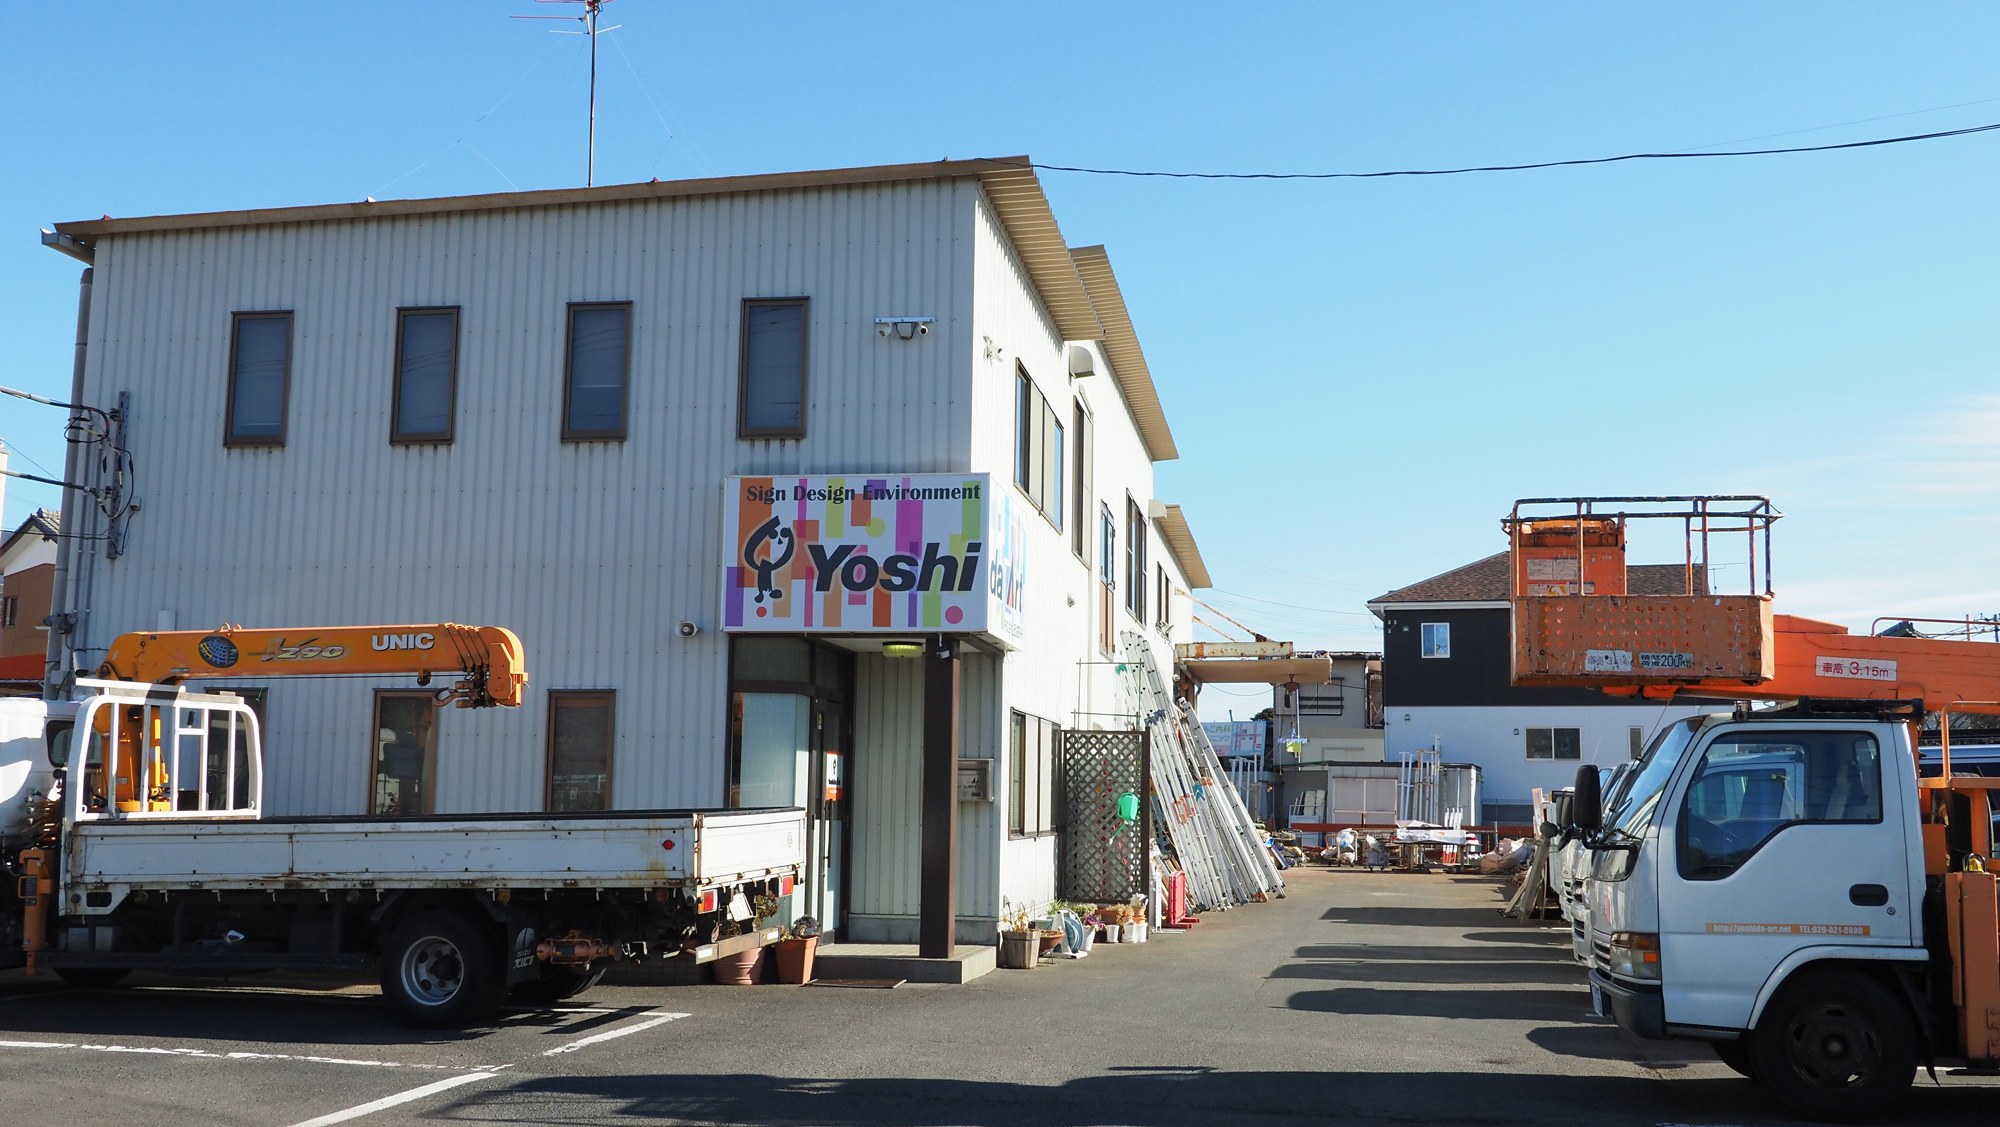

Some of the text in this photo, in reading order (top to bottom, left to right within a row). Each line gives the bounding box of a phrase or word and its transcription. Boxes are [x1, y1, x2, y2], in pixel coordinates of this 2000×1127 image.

[746, 484, 981, 504] Sign Design Environment
[808, 542, 982, 592] Yoshi
[371, 632, 435, 651] UNIC
[1822, 661, 1889, 677] 車高 3.15m
